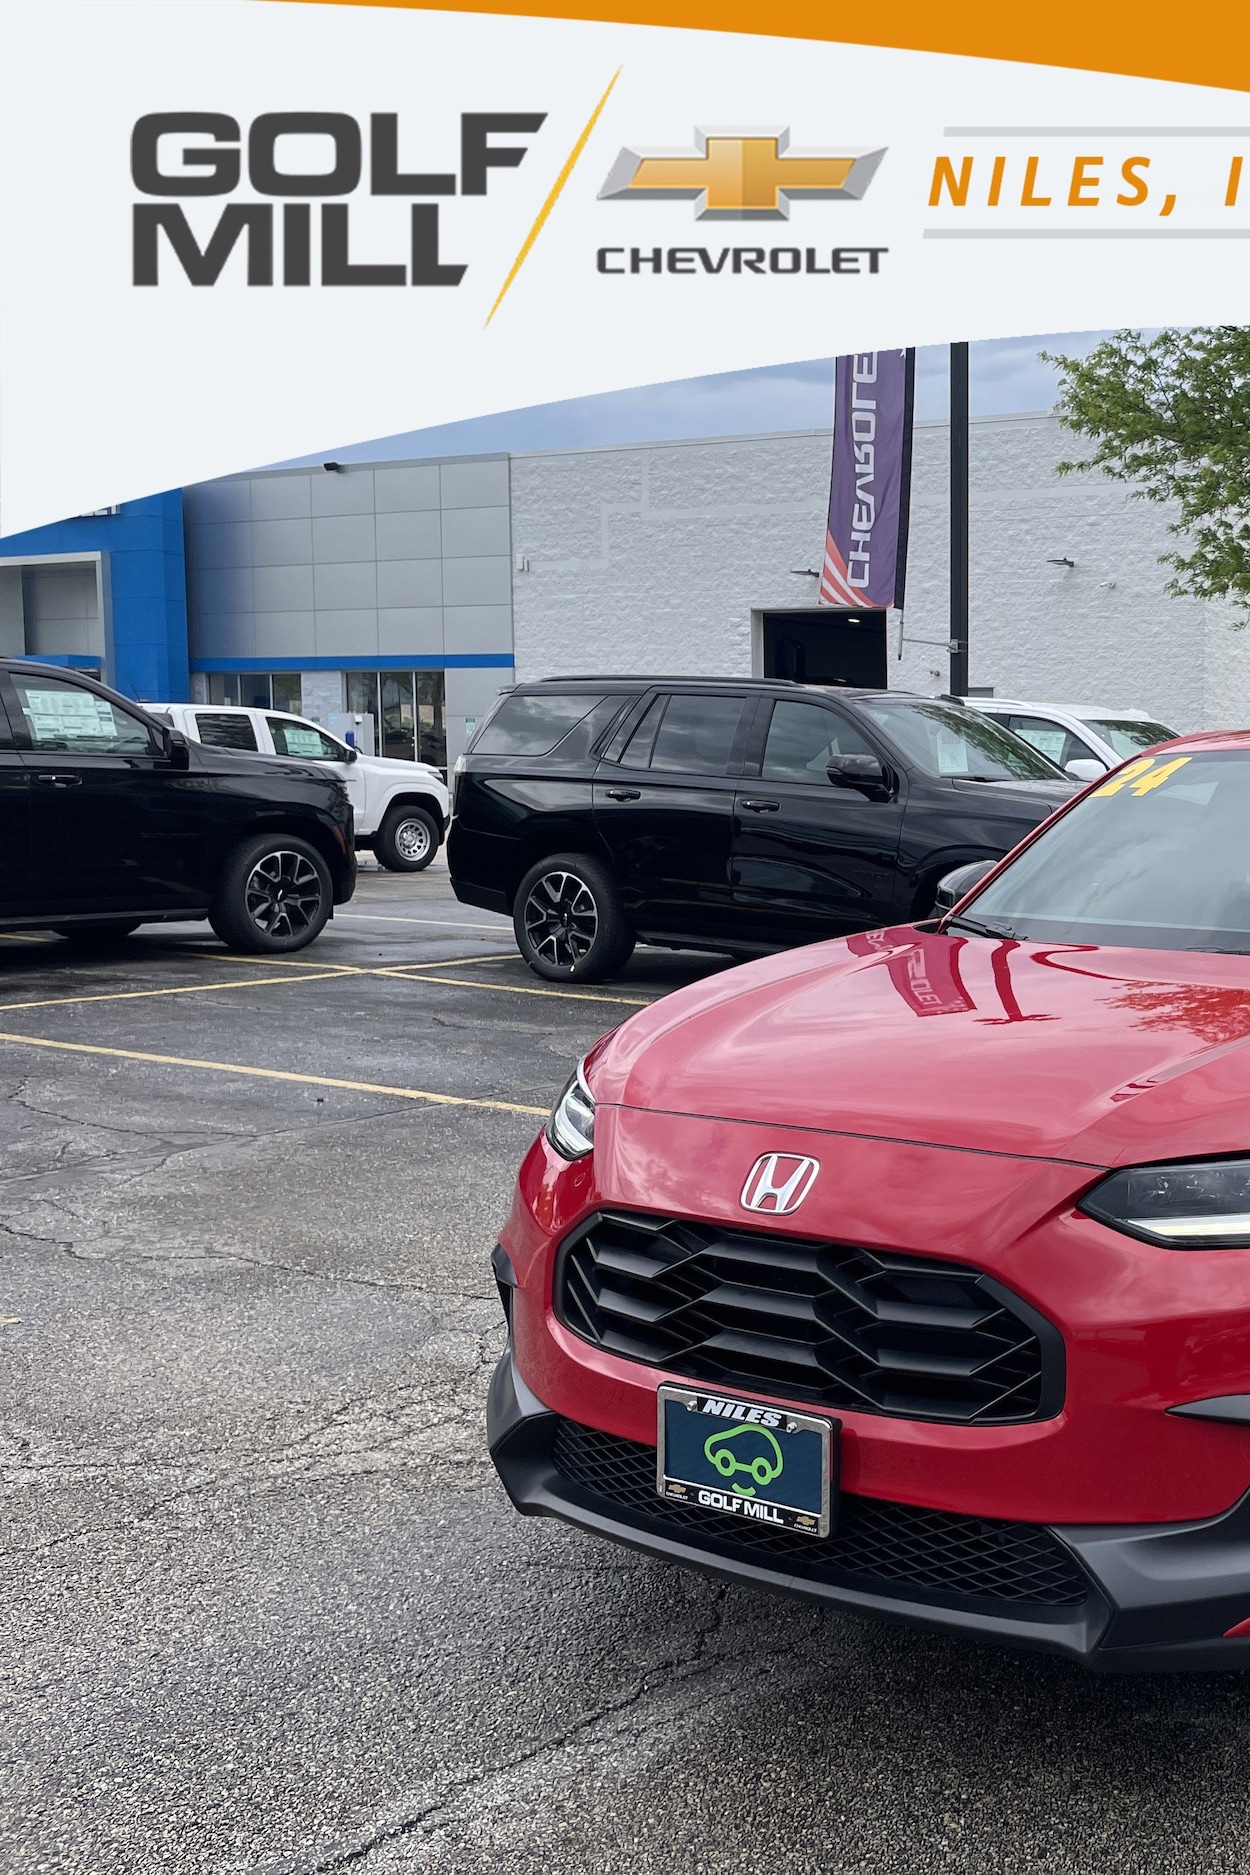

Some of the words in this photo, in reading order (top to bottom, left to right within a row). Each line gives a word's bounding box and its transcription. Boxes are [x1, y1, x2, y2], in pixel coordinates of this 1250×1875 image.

[1088, 757, 1194, 799] 24
[702, 1398, 783, 1428] NILES
[698, 1489, 742, 1513] GOLF
[743, 1499, 784, 1525] MILL
